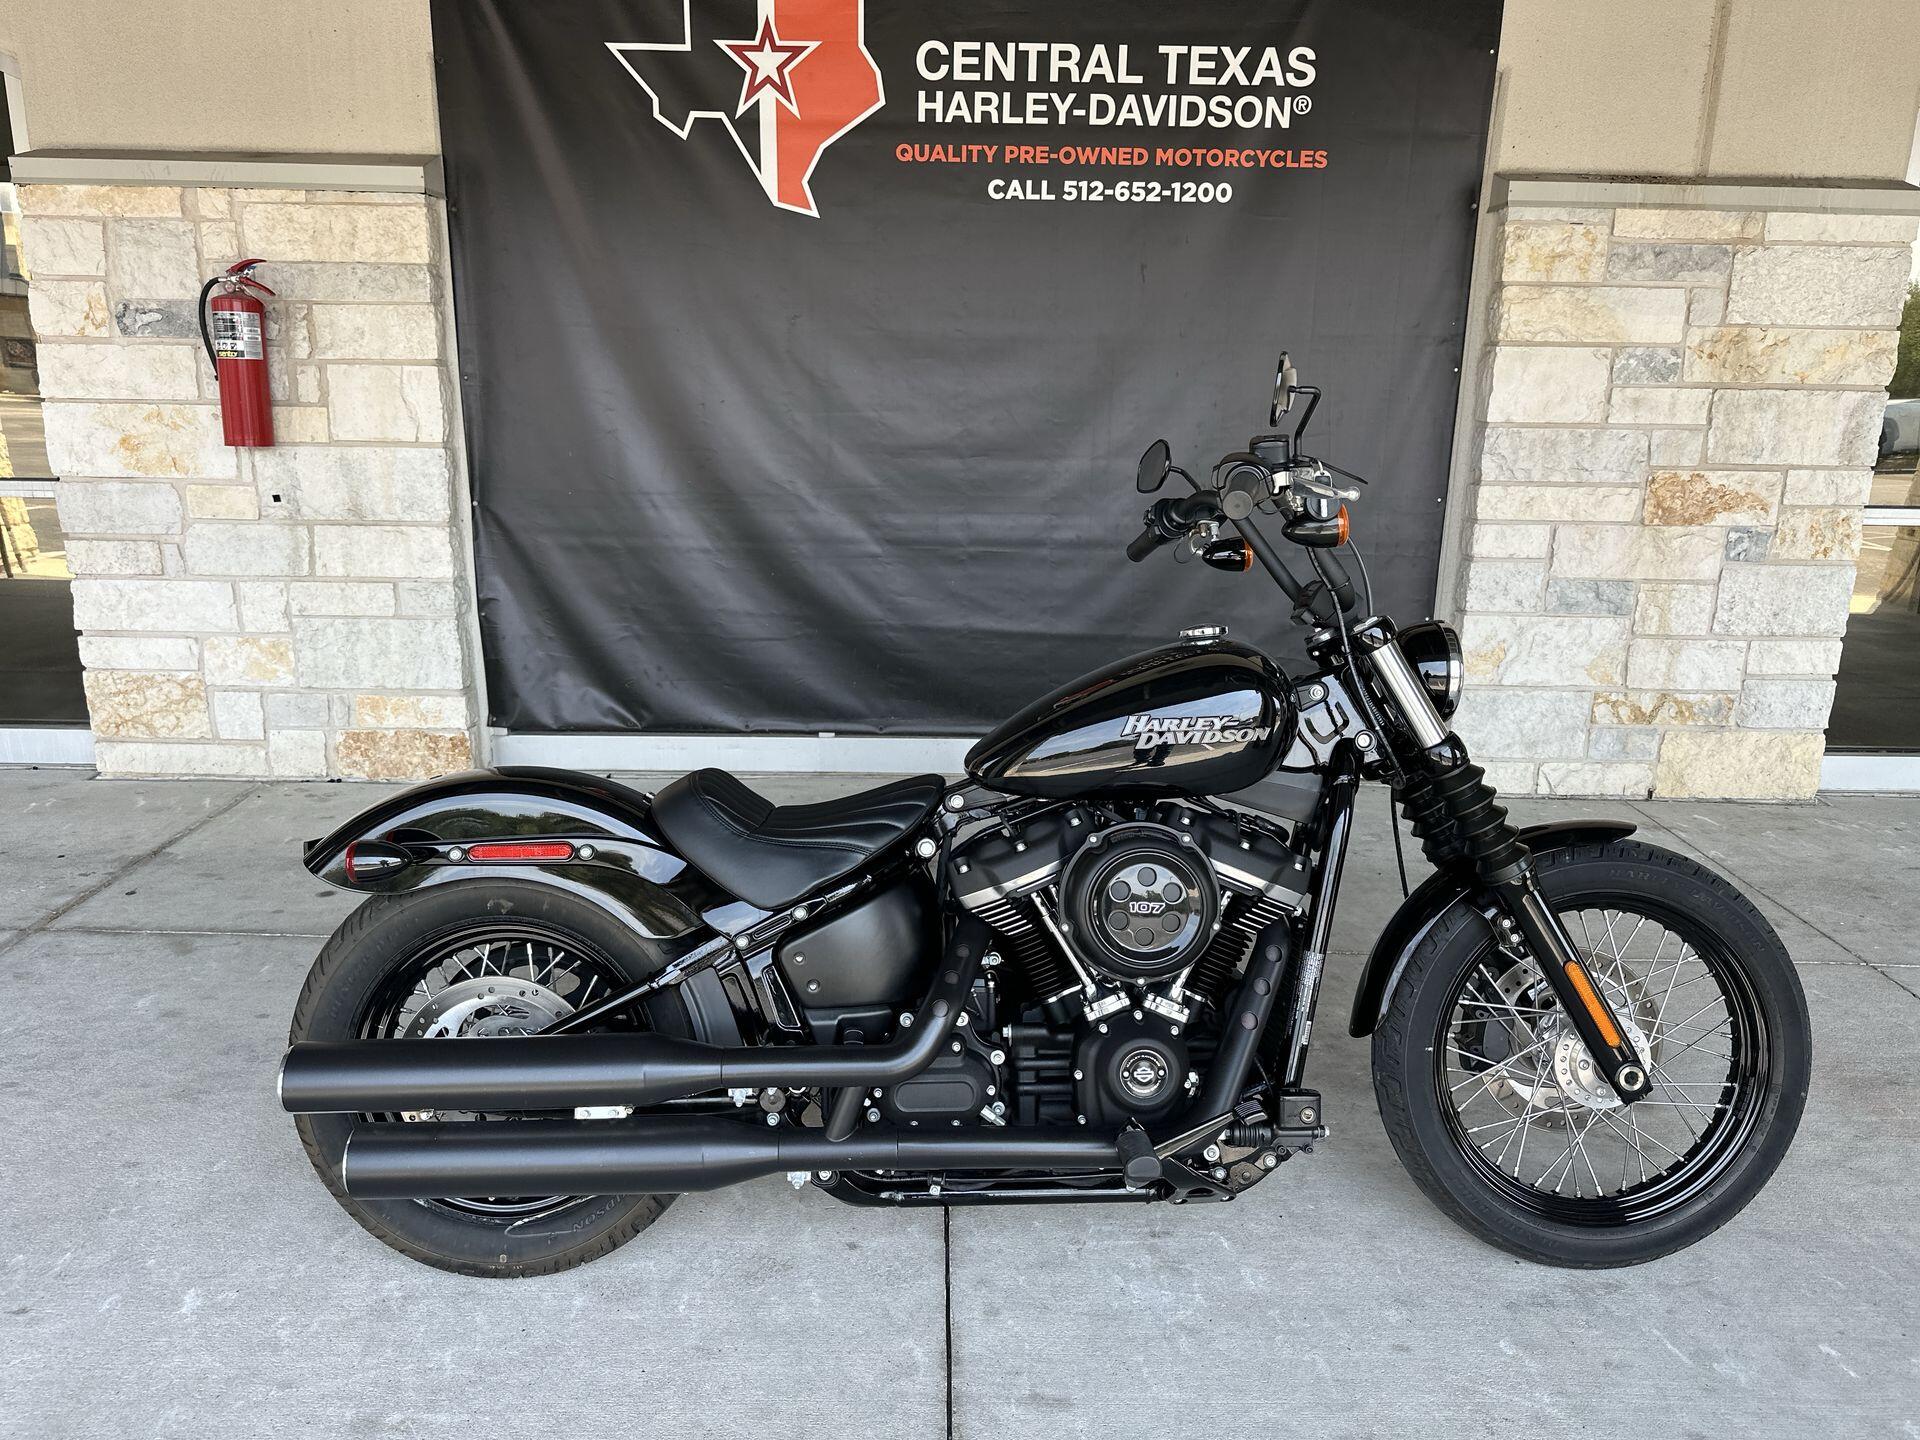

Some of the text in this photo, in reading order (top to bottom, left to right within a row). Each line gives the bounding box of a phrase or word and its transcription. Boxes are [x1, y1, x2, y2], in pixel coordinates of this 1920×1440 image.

[916, 40, 1317, 88] CENTRAL TEXAS
[917, 90, 1313, 129] HARLEY-DAVIDSON®
[895, 143, 1328, 169] QUALITY PRE-OWNED MOTORCYCLES
[987, 178, 1233, 204] CALL 512-652-1200
[1133, 726, 1272, 750] DAVIDSON
[1129, 901, 1166, 914] 107
